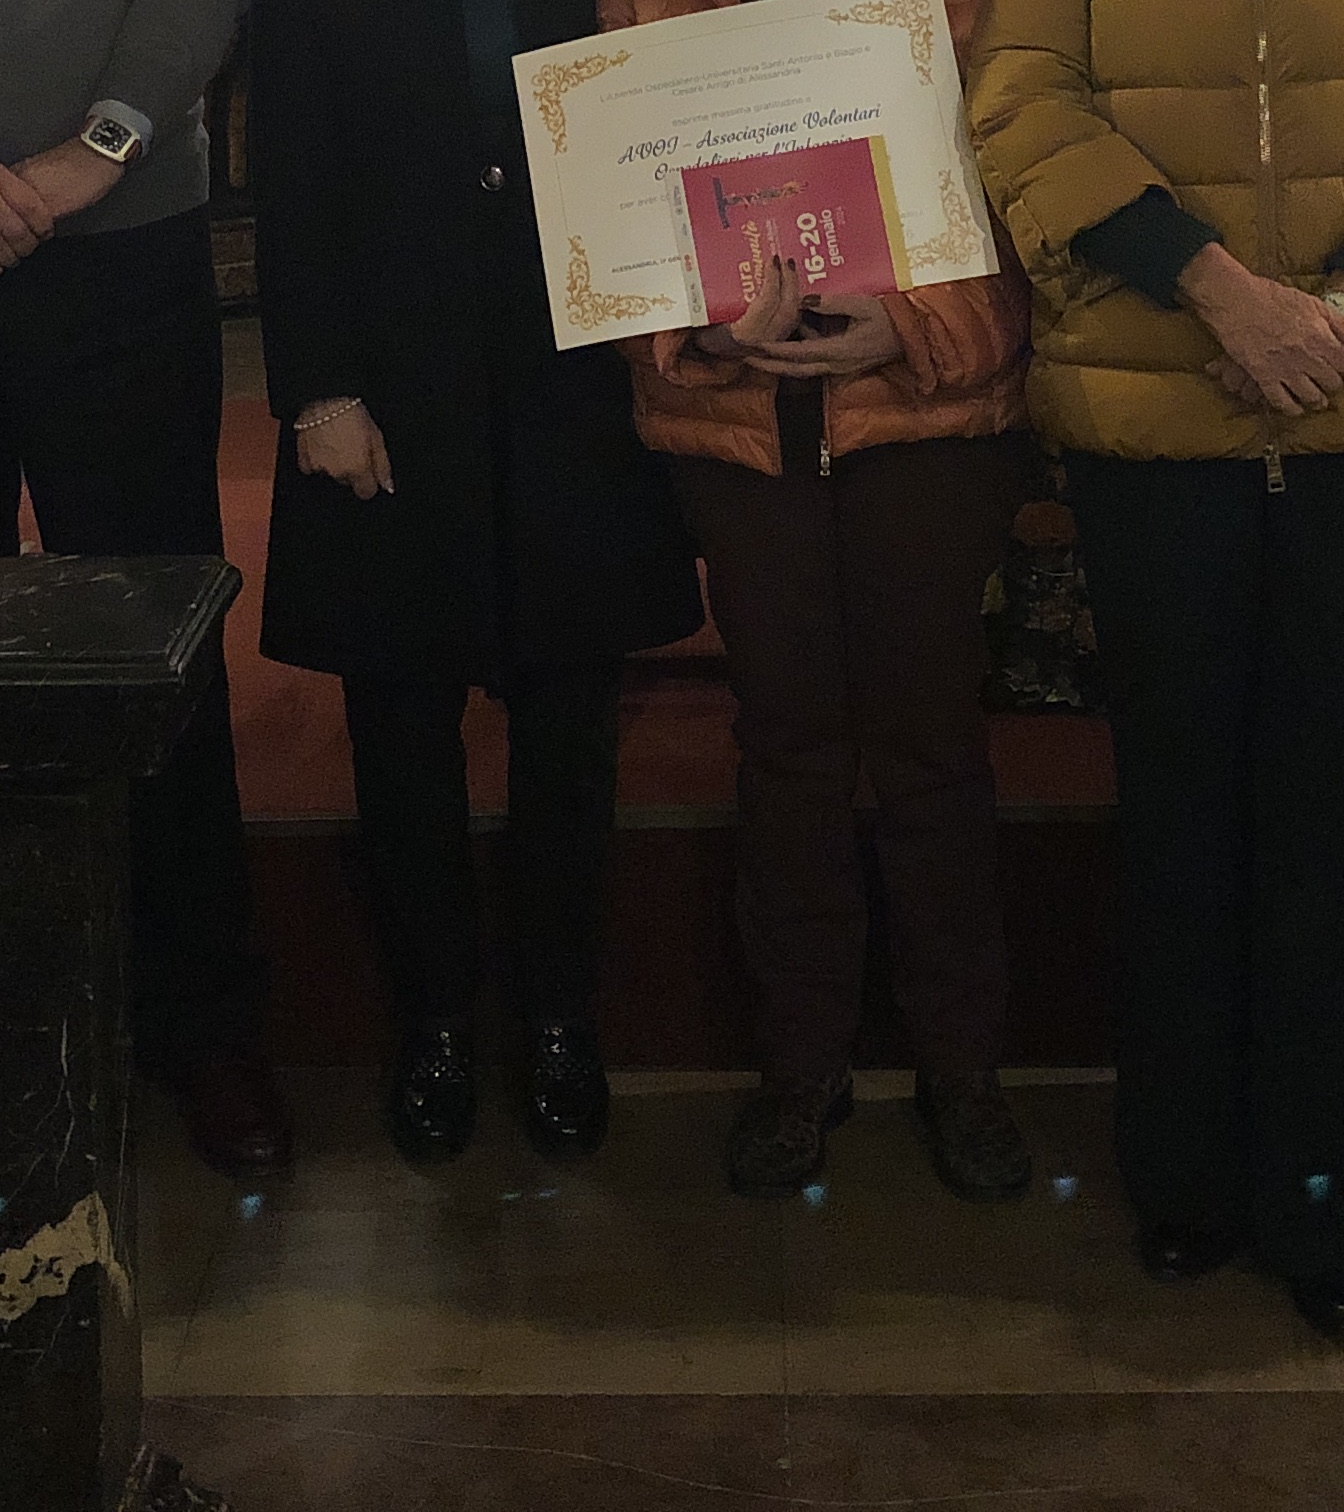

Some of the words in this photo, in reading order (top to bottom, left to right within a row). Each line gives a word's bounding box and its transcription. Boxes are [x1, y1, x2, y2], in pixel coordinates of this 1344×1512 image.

[696, 120, 798, 149] Associazione
[802, 103, 882, 129] Volontari
[796, 212, 827, 284] 16-20
[820, 209, 845, 266] gennaio
[738, 261, 756, 303] cura
